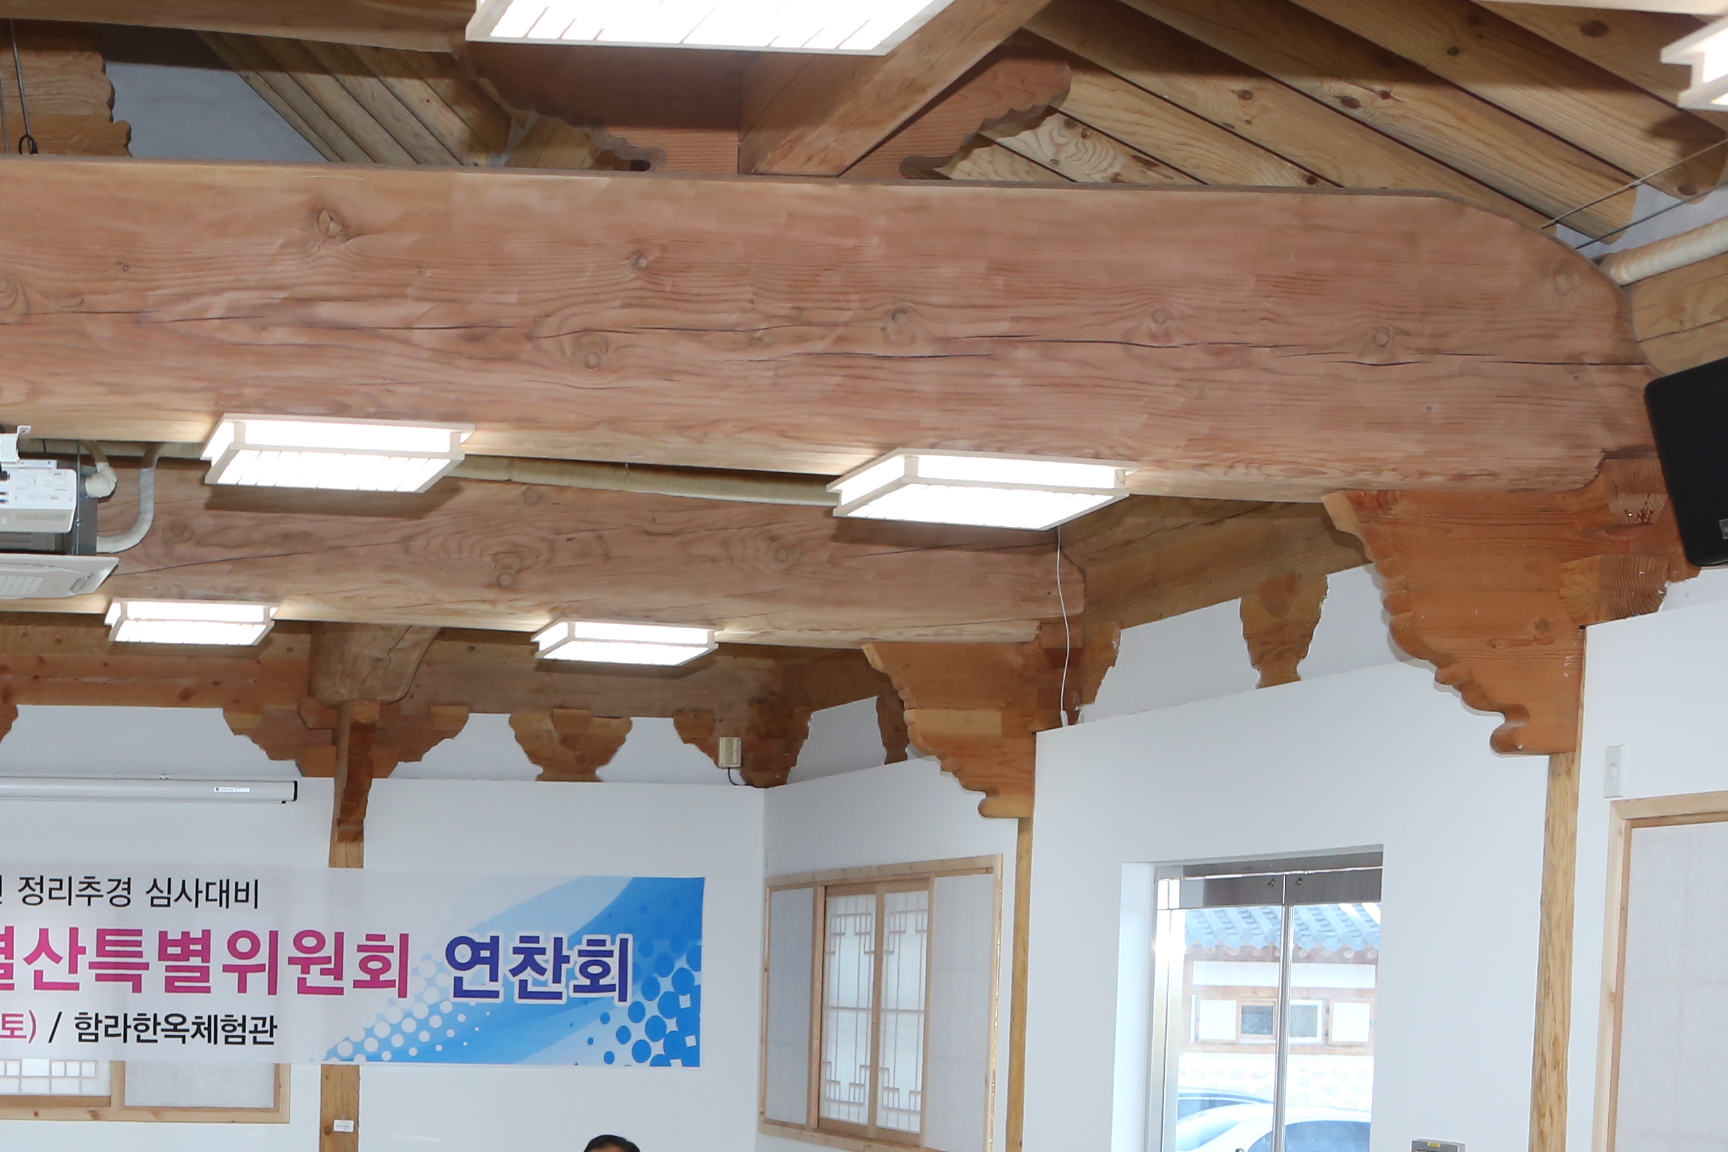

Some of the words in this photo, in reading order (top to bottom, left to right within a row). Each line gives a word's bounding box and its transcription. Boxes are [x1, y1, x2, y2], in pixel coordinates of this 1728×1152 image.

[17, 876, 132, 908] 정리추경
[145, 878, 259, 910] 심사대비
[445, 933, 632, 1004] 연찬회
[74, 1012, 278, 1046] 함라한옥체험관
